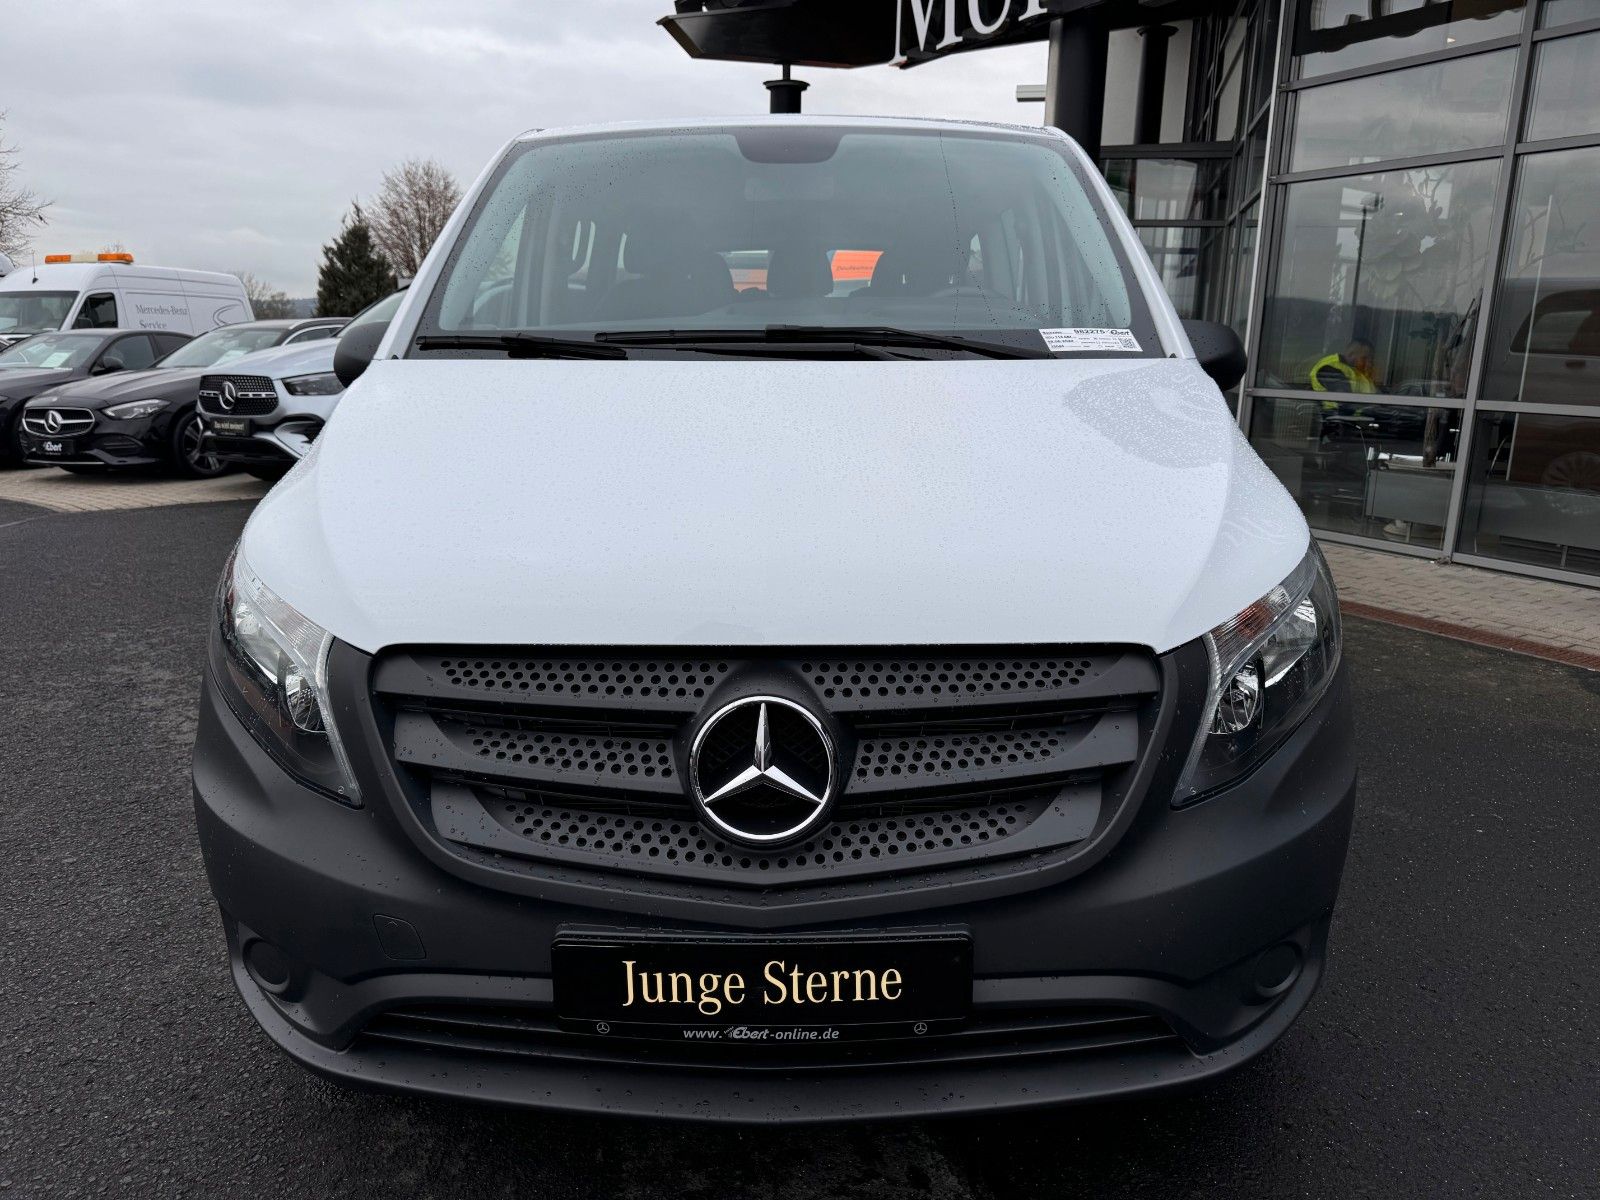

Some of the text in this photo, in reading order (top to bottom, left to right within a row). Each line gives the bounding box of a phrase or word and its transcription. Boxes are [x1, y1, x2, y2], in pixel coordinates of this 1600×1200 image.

[135, 304, 188, 315] Mercedes-Benz
[139, 319, 167, 329] Service
[621, 960, 903, 1016] Junge Sterne
